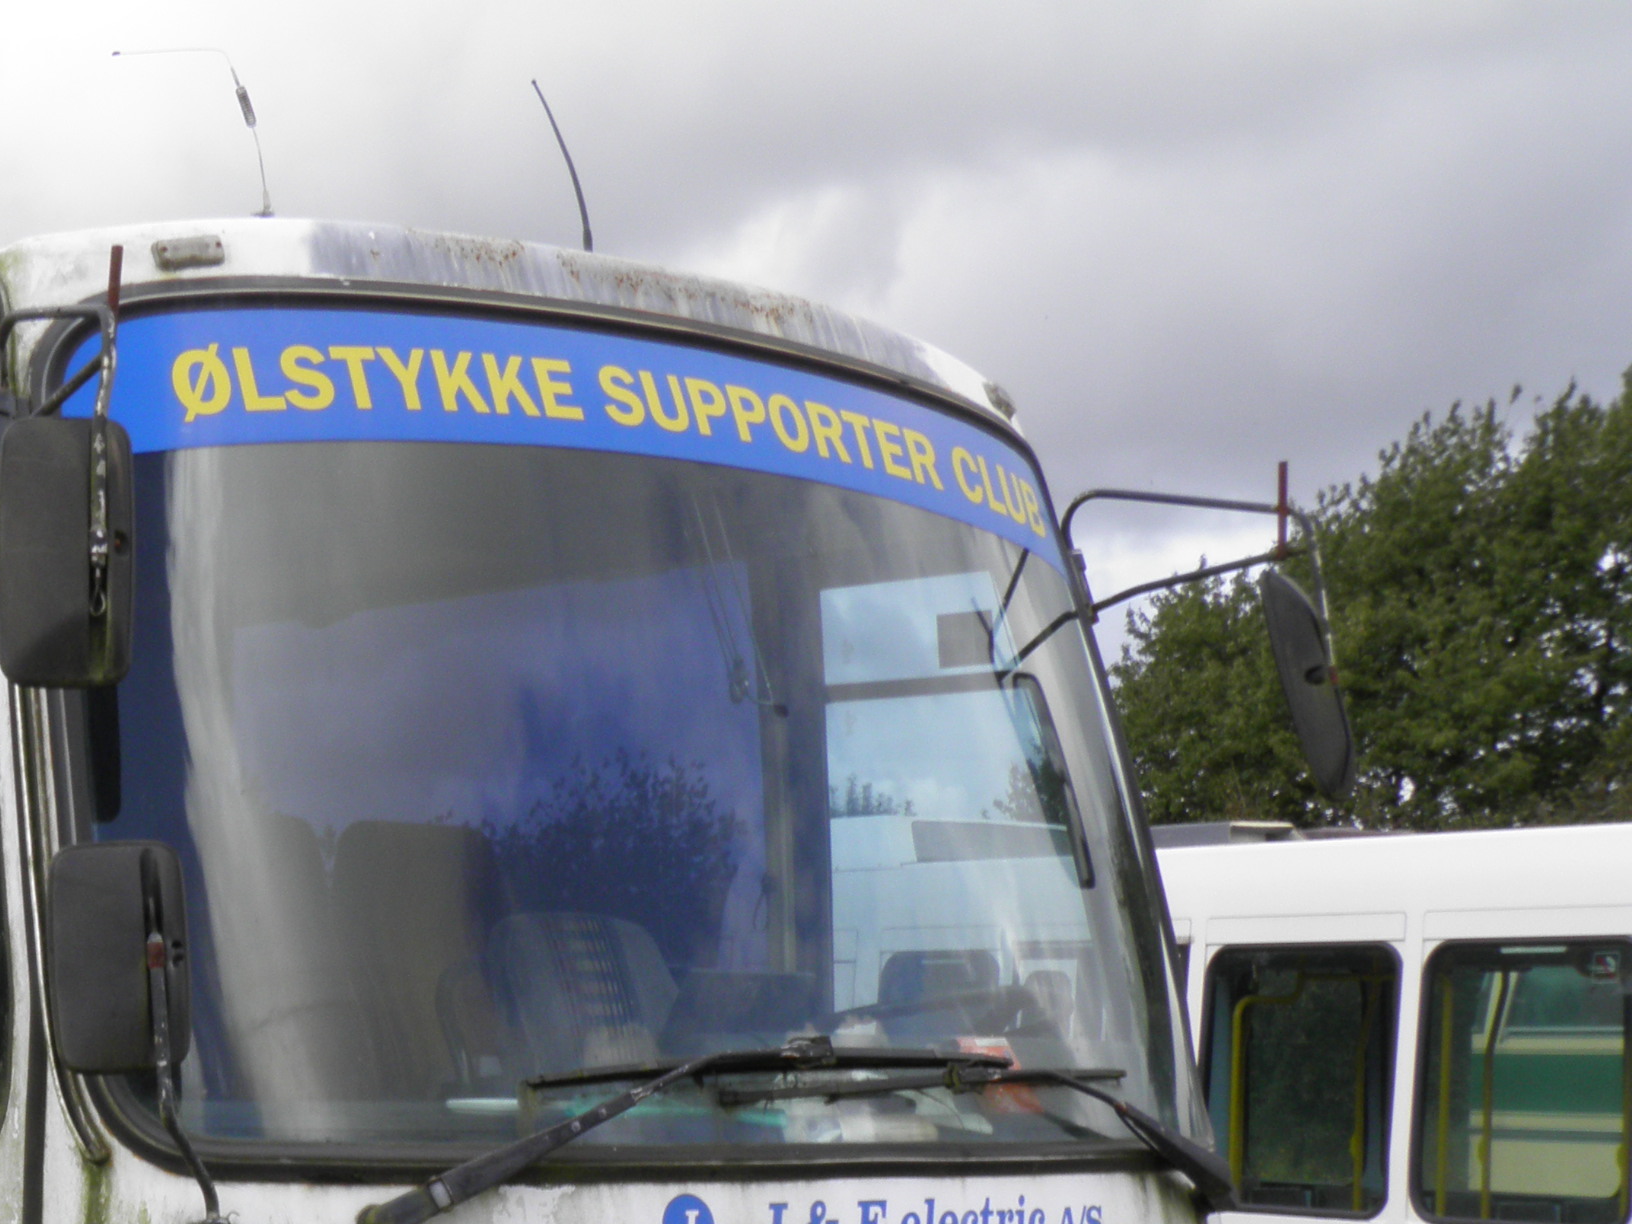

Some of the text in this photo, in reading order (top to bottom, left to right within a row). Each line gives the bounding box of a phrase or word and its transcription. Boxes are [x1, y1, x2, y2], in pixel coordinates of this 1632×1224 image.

[171, 342, 1047, 540] ØLSTYKKE SUPPORTER CLUB
